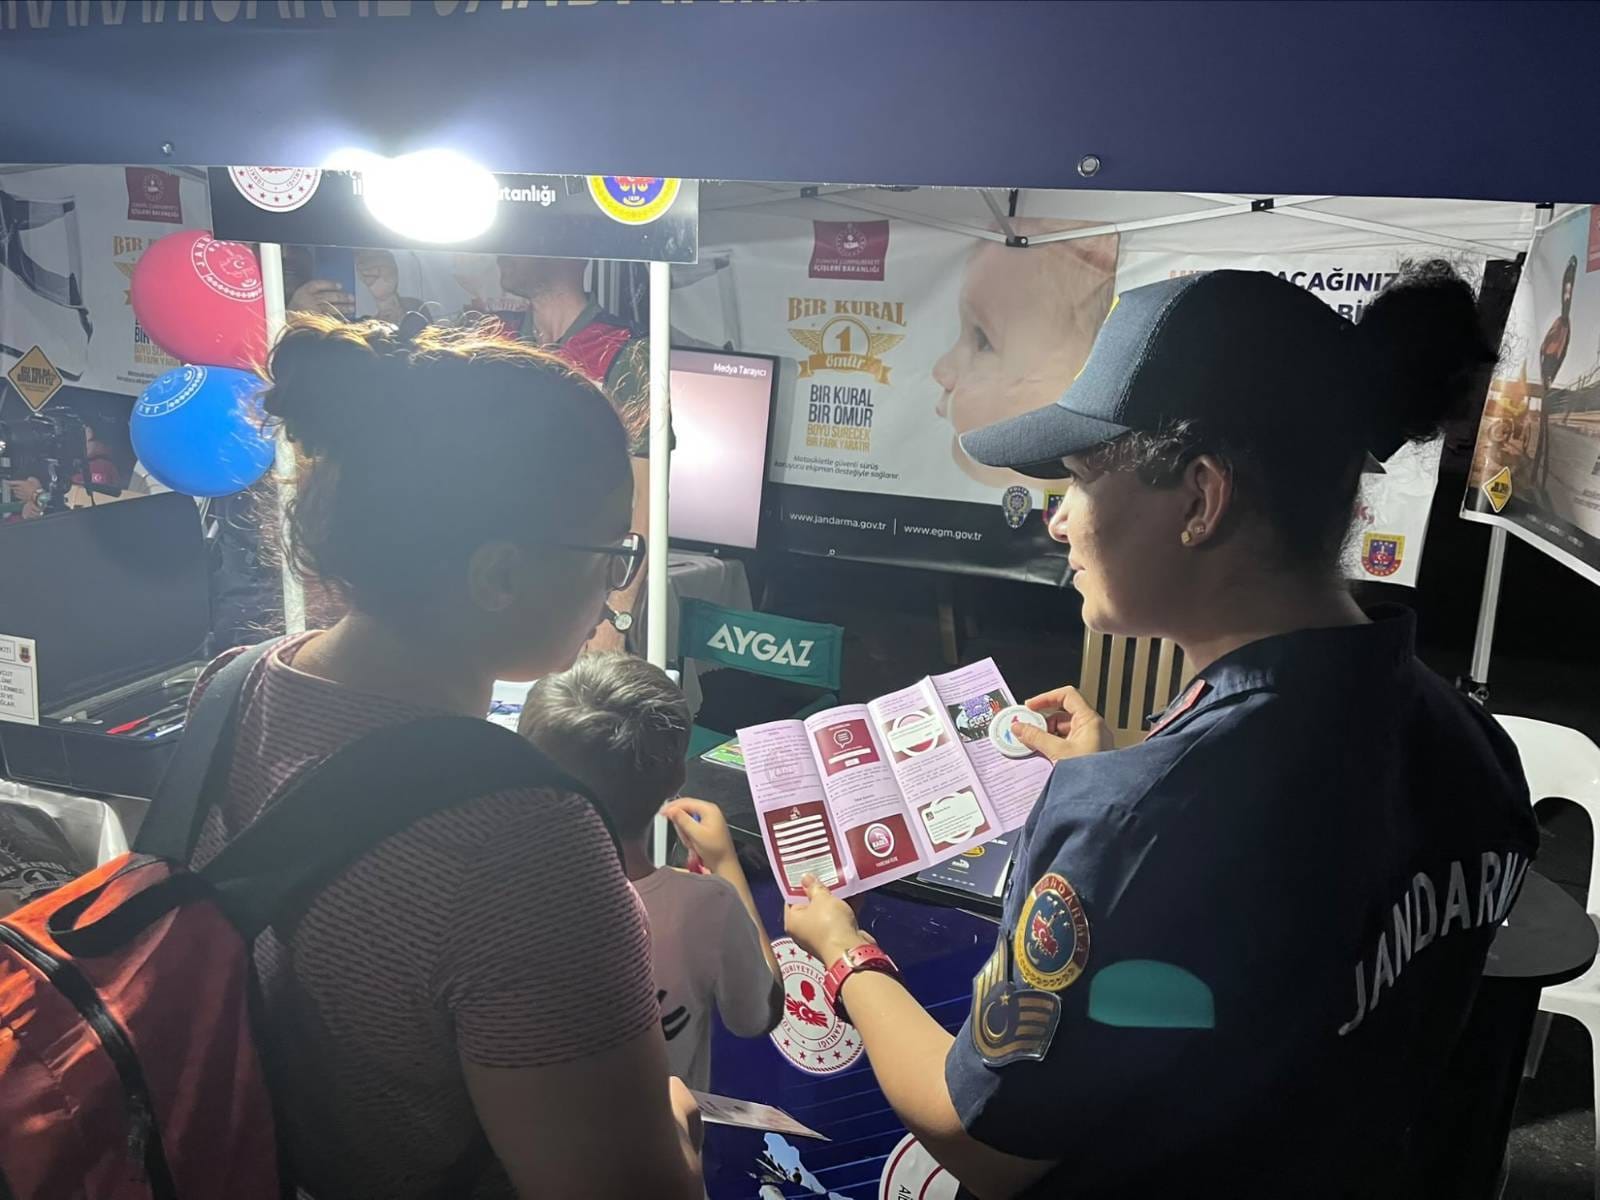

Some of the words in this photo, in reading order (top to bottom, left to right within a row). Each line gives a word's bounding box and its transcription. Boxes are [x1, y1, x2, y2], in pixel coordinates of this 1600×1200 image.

[499, 184, 556, 206] tanlığı
[834, 300, 907, 327] KURAL
[835, 326, 851, 352] 1
[713, 362, 738, 375] Medya
[739, 366, 767, 377] Tarayıcı
[833, 386, 874, 407] KURAL
[789, 511, 887, 531] www.jandarma.gov.tr
[903, 524, 983, 542] www.egm.gov.tr
[706, 623, 815, 668] AYGAZ
[1338, 851, 1529, 1036] JANDARM
